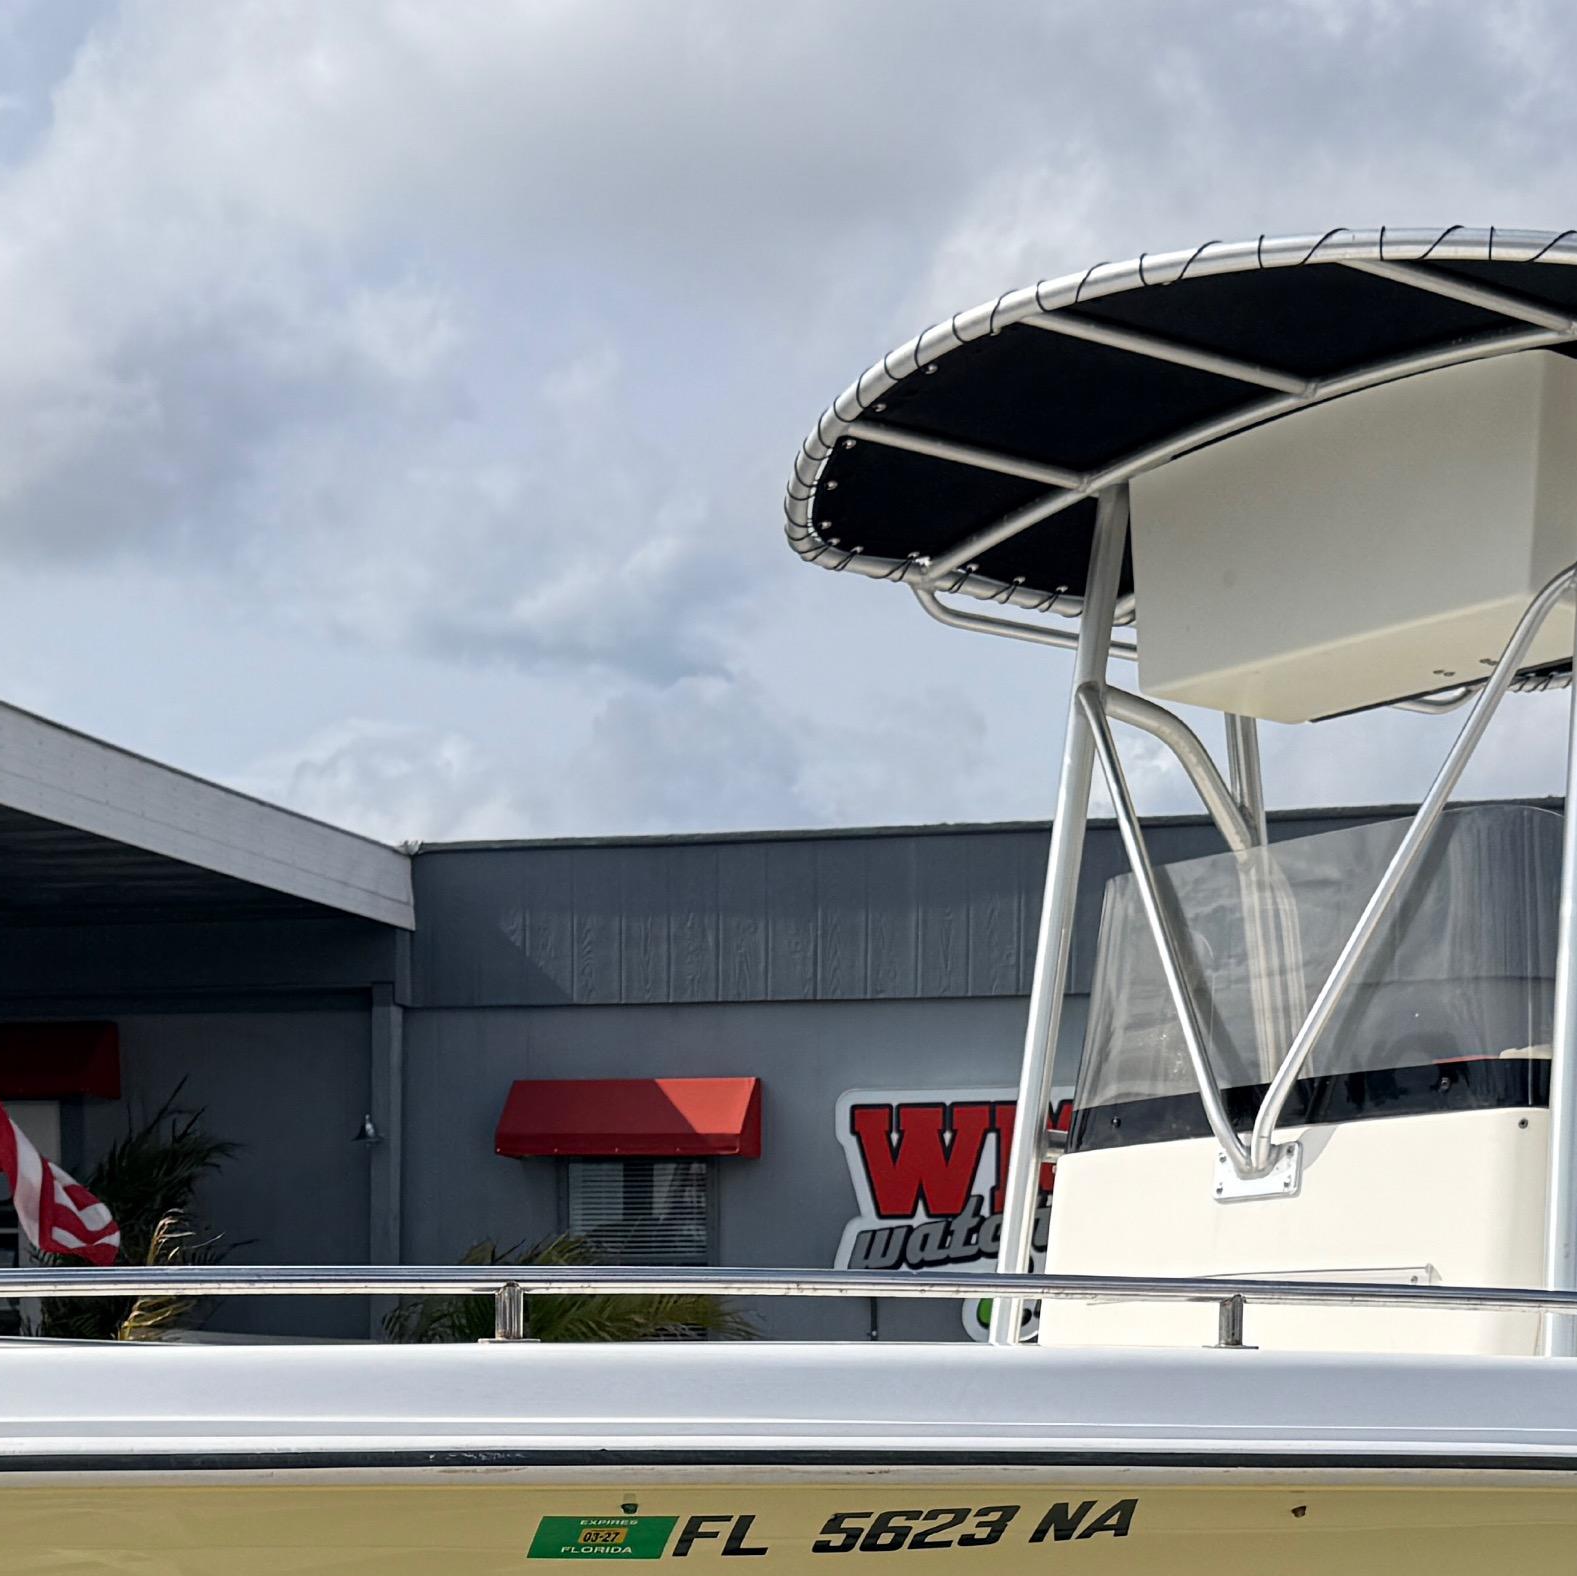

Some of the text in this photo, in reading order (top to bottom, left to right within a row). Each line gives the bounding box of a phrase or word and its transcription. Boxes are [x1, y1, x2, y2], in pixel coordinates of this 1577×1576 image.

[671, 1498, 1139, 1557] FL 5623 NA
[582, 1531, 621, 1543] 03-27
[560, 1546, 633, 1554] FLORIDA
